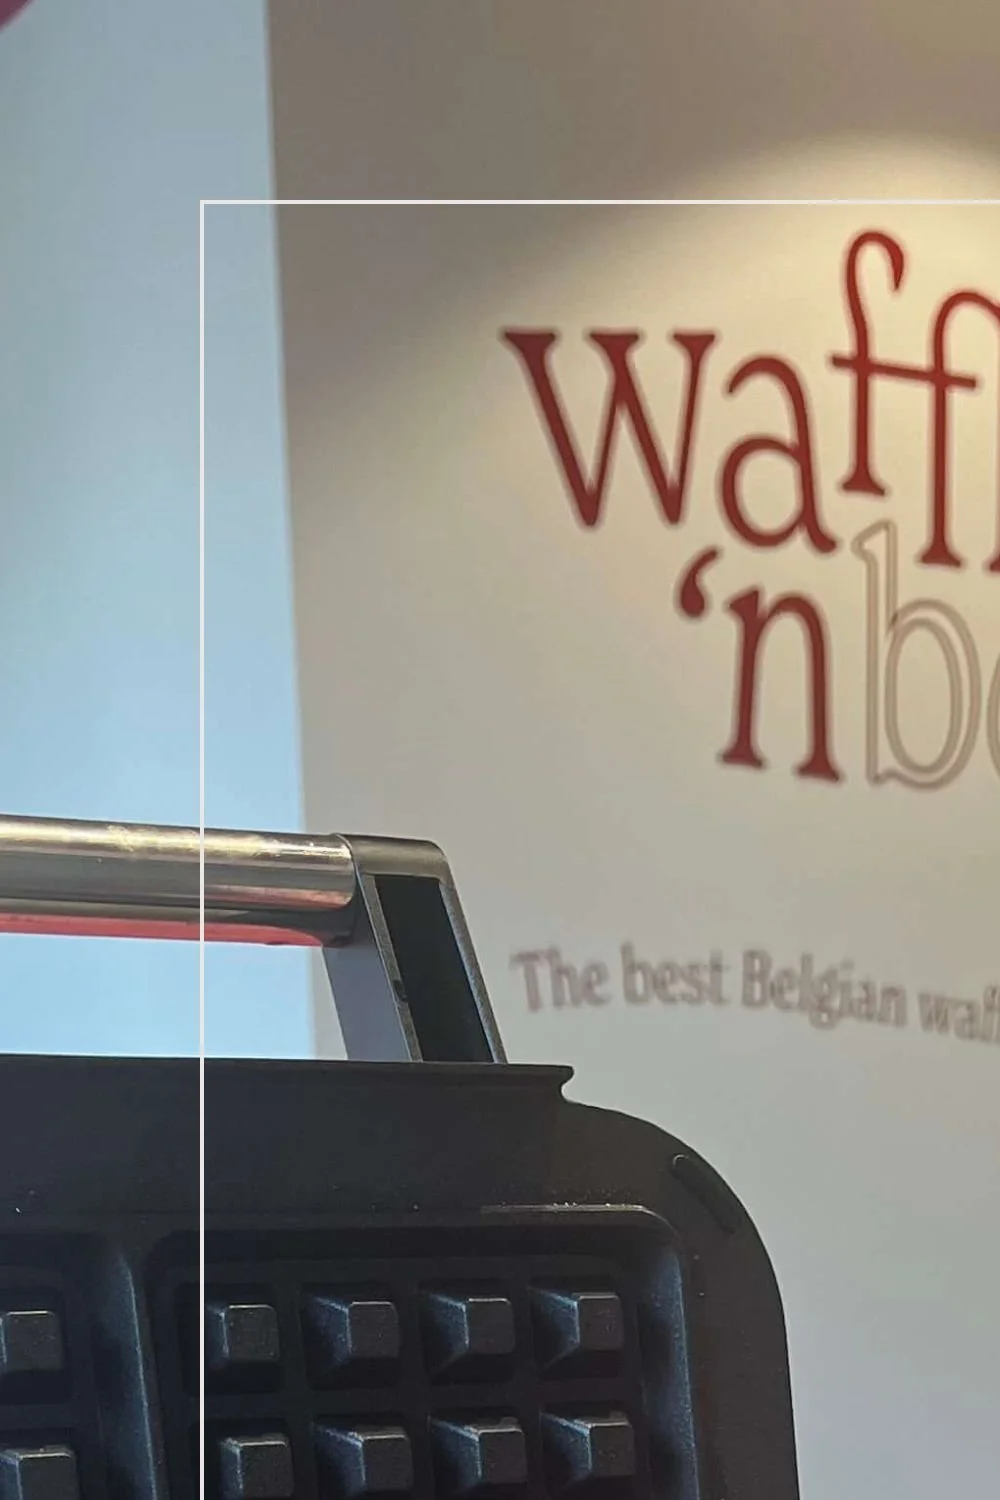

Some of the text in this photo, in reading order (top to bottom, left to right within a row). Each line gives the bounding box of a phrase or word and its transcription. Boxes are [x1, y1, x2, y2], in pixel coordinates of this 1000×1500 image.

[510, 947, 612, 1013] The
[620, 942, 731, 1006] best
[741, 949, 907, 1031] Belgian
